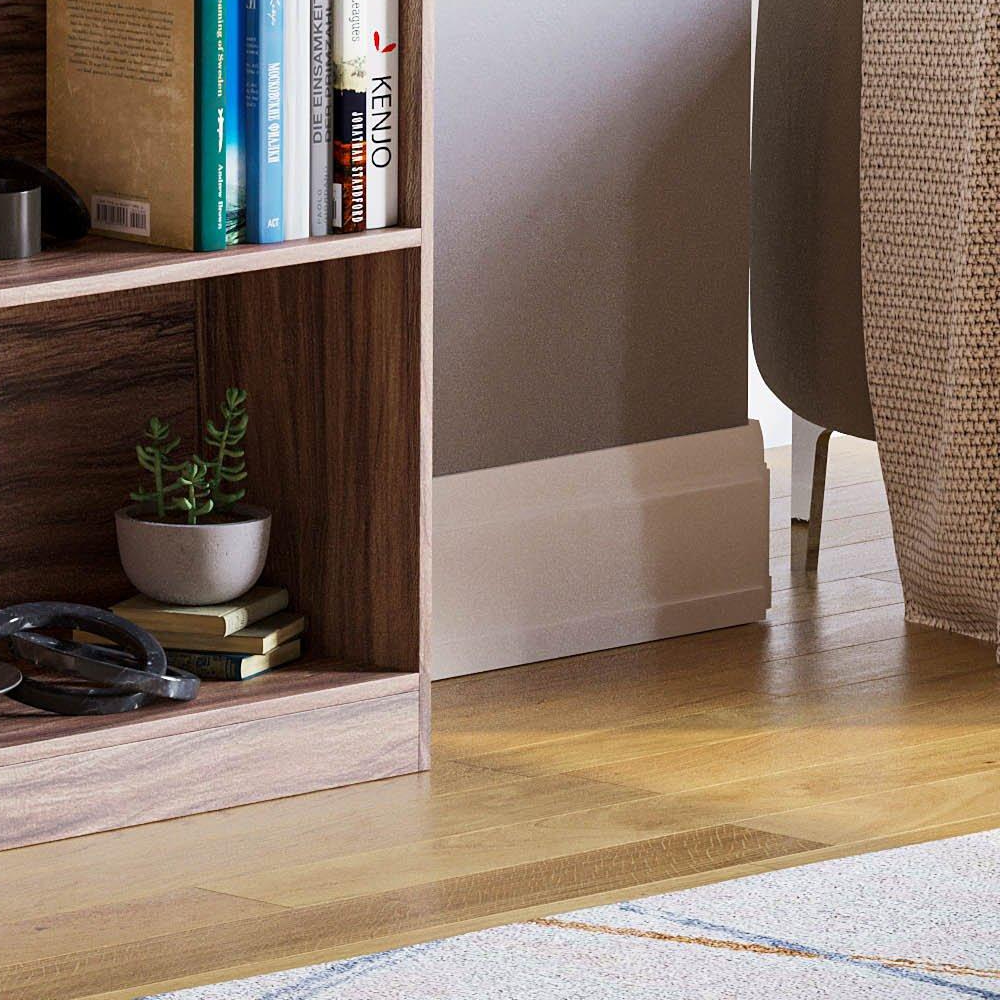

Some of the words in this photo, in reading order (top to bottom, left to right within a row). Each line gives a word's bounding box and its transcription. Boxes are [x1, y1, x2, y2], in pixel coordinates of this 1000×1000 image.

[217, 40, 224, 52] of
[313, 113, 323, 144] DIE
[351, 111, 363, 162] JONATHAN
[371, 75, 392, 168] KENJO
[351, 166, 364, 223] STANDFORD
